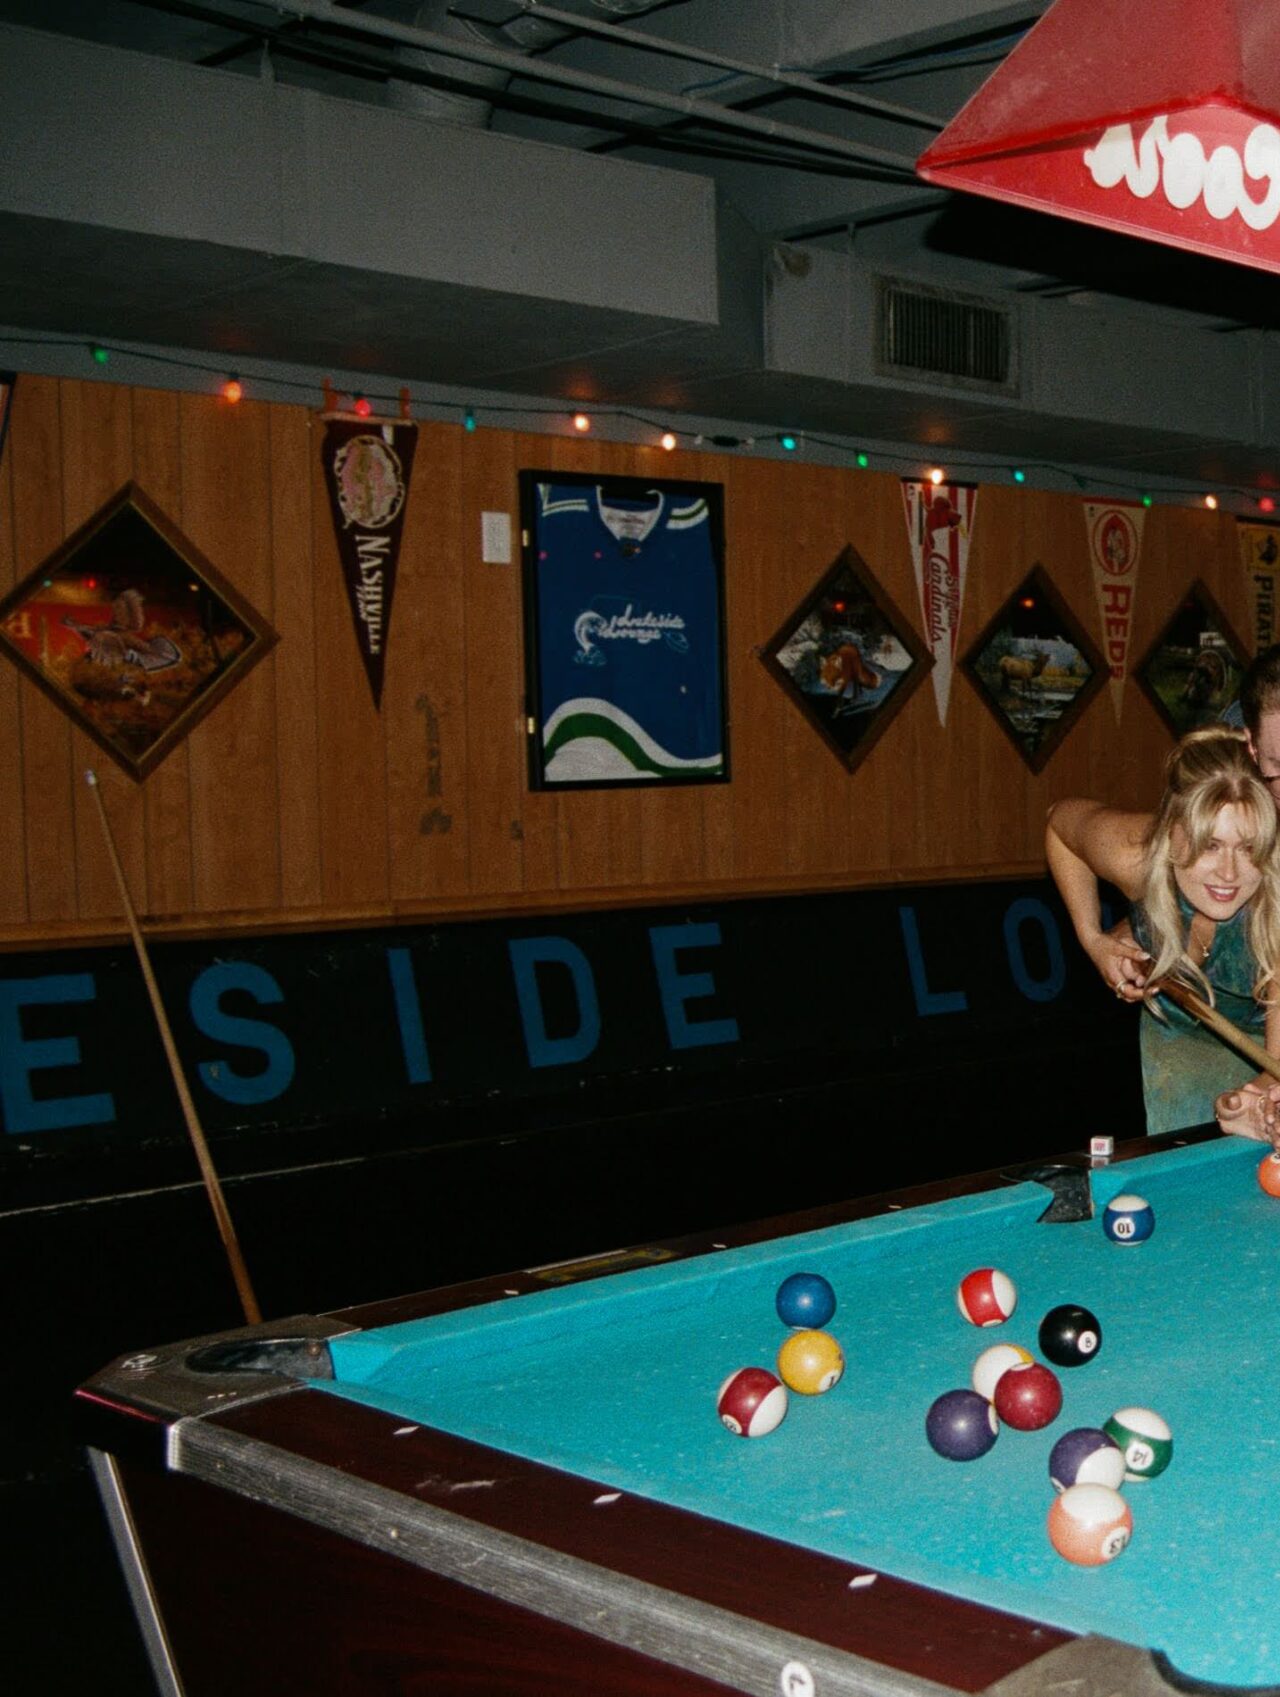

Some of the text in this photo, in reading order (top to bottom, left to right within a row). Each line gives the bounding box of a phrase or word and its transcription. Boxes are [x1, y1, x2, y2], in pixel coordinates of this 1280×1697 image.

[355, 535, 391, 654] NASHVILLE
[928, 552, 949, 642] Cardinals
[1102, 584, 1131, 679] REDS
[898, 897, 1114, 1017] LO
[1117, 1222, 1133, 1235] 10
[1085, 1336, 1093, 1348] 8
[1131, 1449, 1148, 1467] 14
